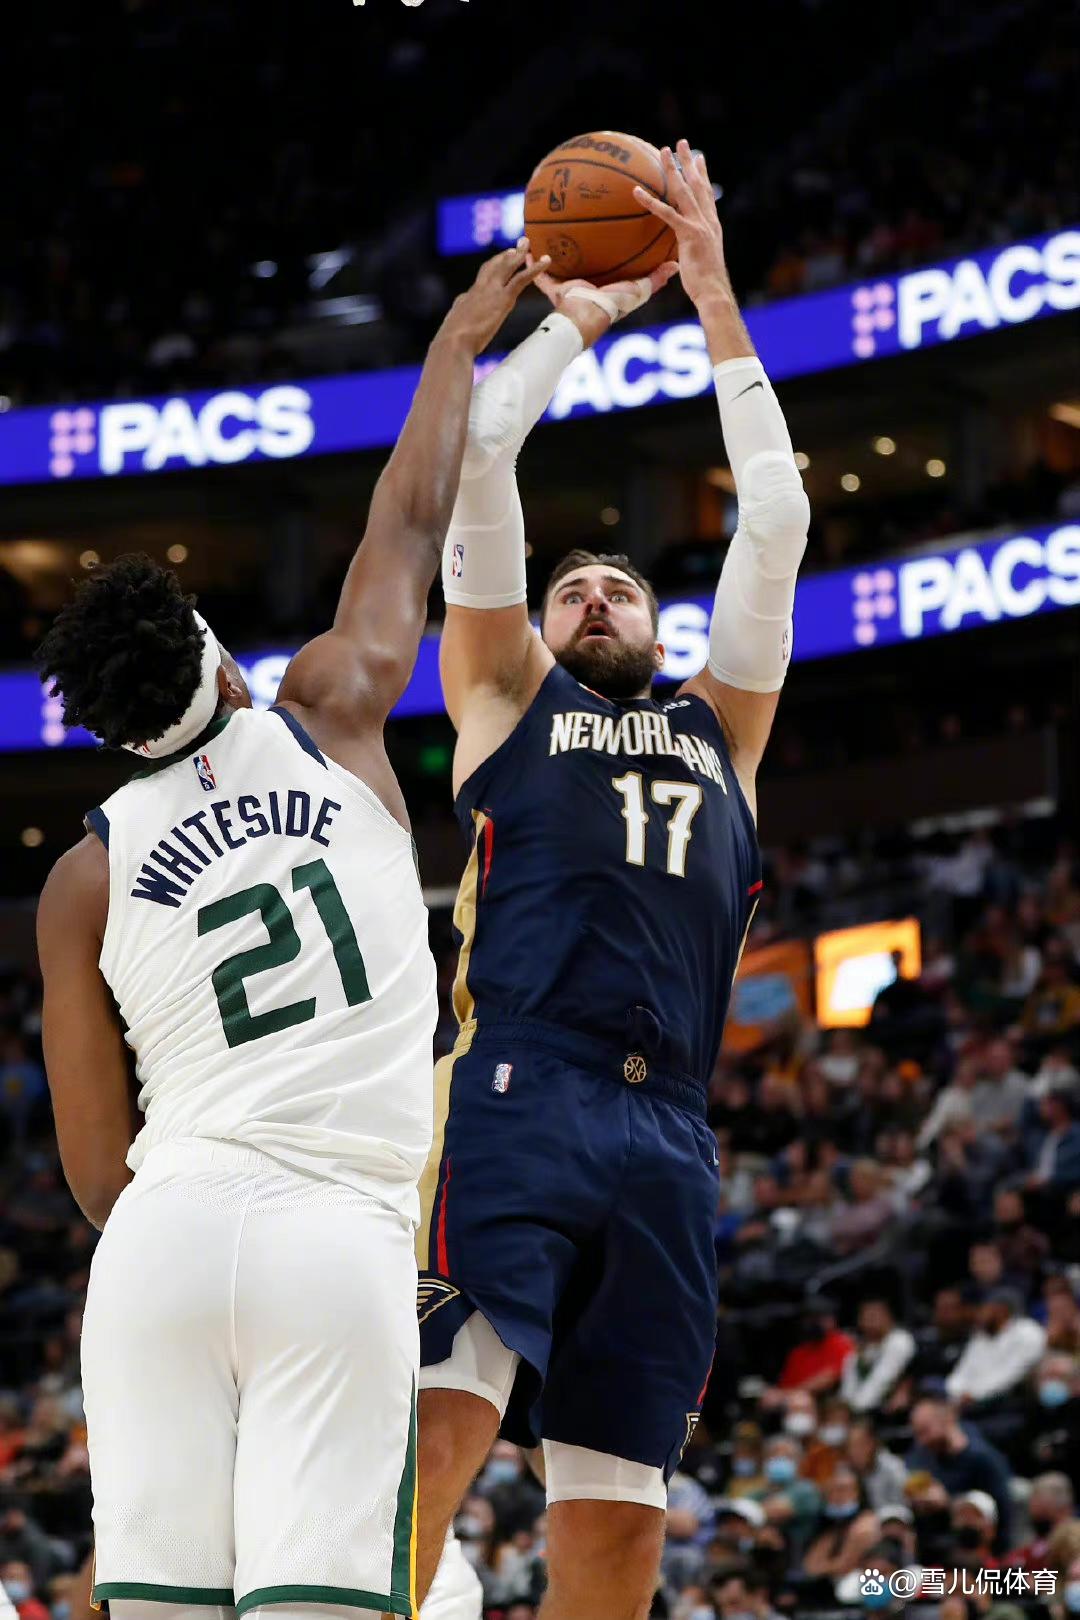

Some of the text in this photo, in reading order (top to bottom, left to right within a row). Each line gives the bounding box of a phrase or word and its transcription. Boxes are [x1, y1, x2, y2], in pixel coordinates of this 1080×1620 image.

[898, 231, 1080, 350] PACS
[548, 324, 712, 420] ACS
[100, 385, 314, 475] PACS
[900, 525, 1080, 639] PACS
[620, 709, 728, 796] ORLANS
[130, 790, 342, 908] WHITESIDE
[611, 770, 704, 878] 17
[198, 858, 374, 1049] 21
